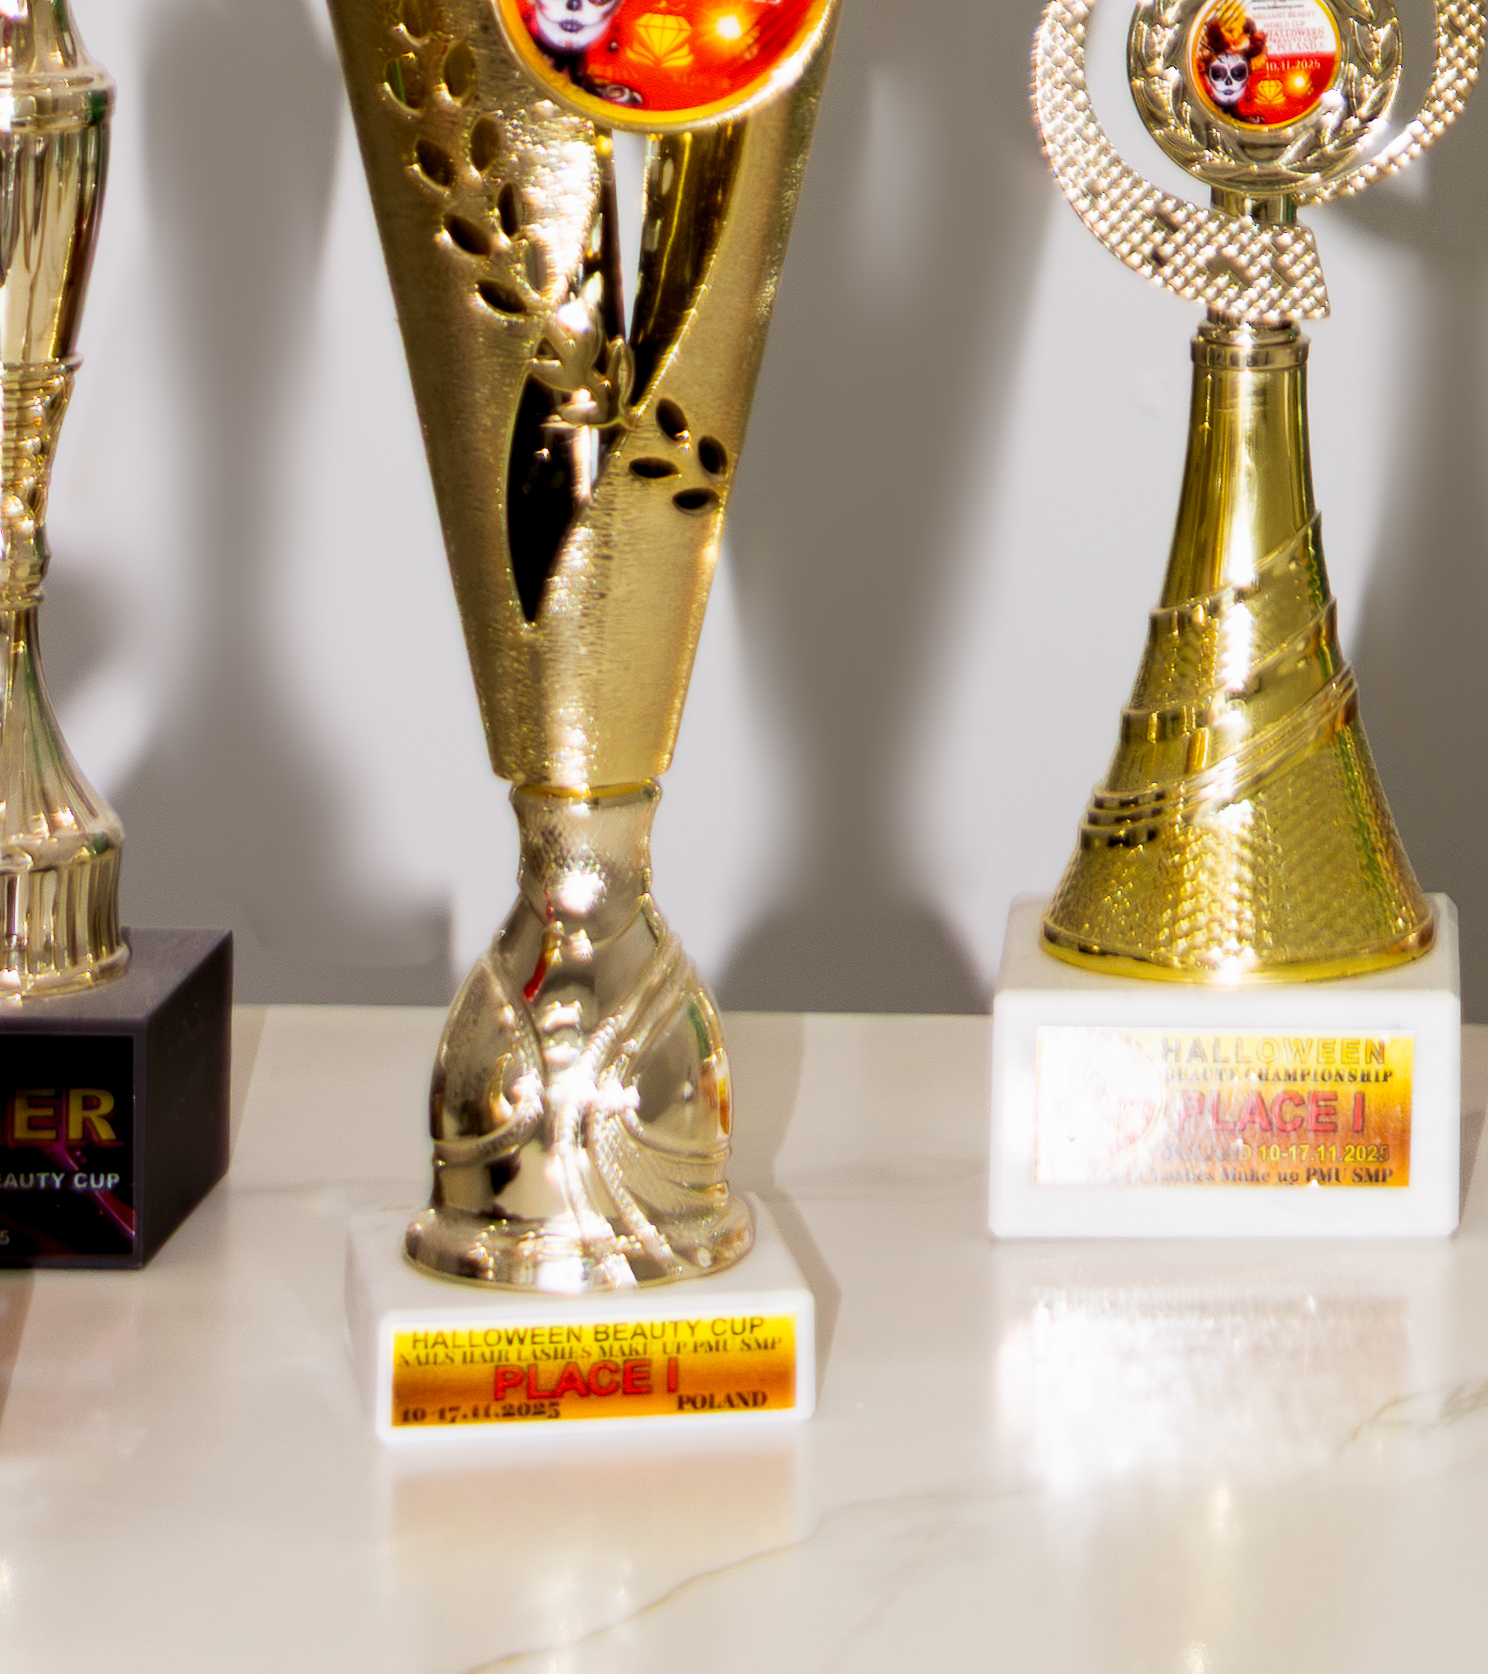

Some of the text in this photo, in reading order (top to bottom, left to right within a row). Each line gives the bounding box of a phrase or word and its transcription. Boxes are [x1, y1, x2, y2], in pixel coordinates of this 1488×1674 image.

[1161, 1036, 1386, 1065] HALLOWEEN
[1178, 1090, 1338, 1133] PLACE
[1259, 1144, 1391, 1163] 10-17.11.2025
[73, 1173, 120, 1190] CUP
[1305, 1167, 1347, 1183] PMU
[1352, 1167, 1394, 1184] SMP
[411, 1316, 766, 1350] HALLOWEEN BEAUTY CUP
[399, 1350, 455, 1367] NAILS
[462, 1348, 509, 1365] HAIR
[517, 1345, 592, 1362] LASHES
[740, 1336, 783, 1352] SMP
[494, 1357, 652, 1402] PLACE
[677, 1391, 768, 1411] POLAND
